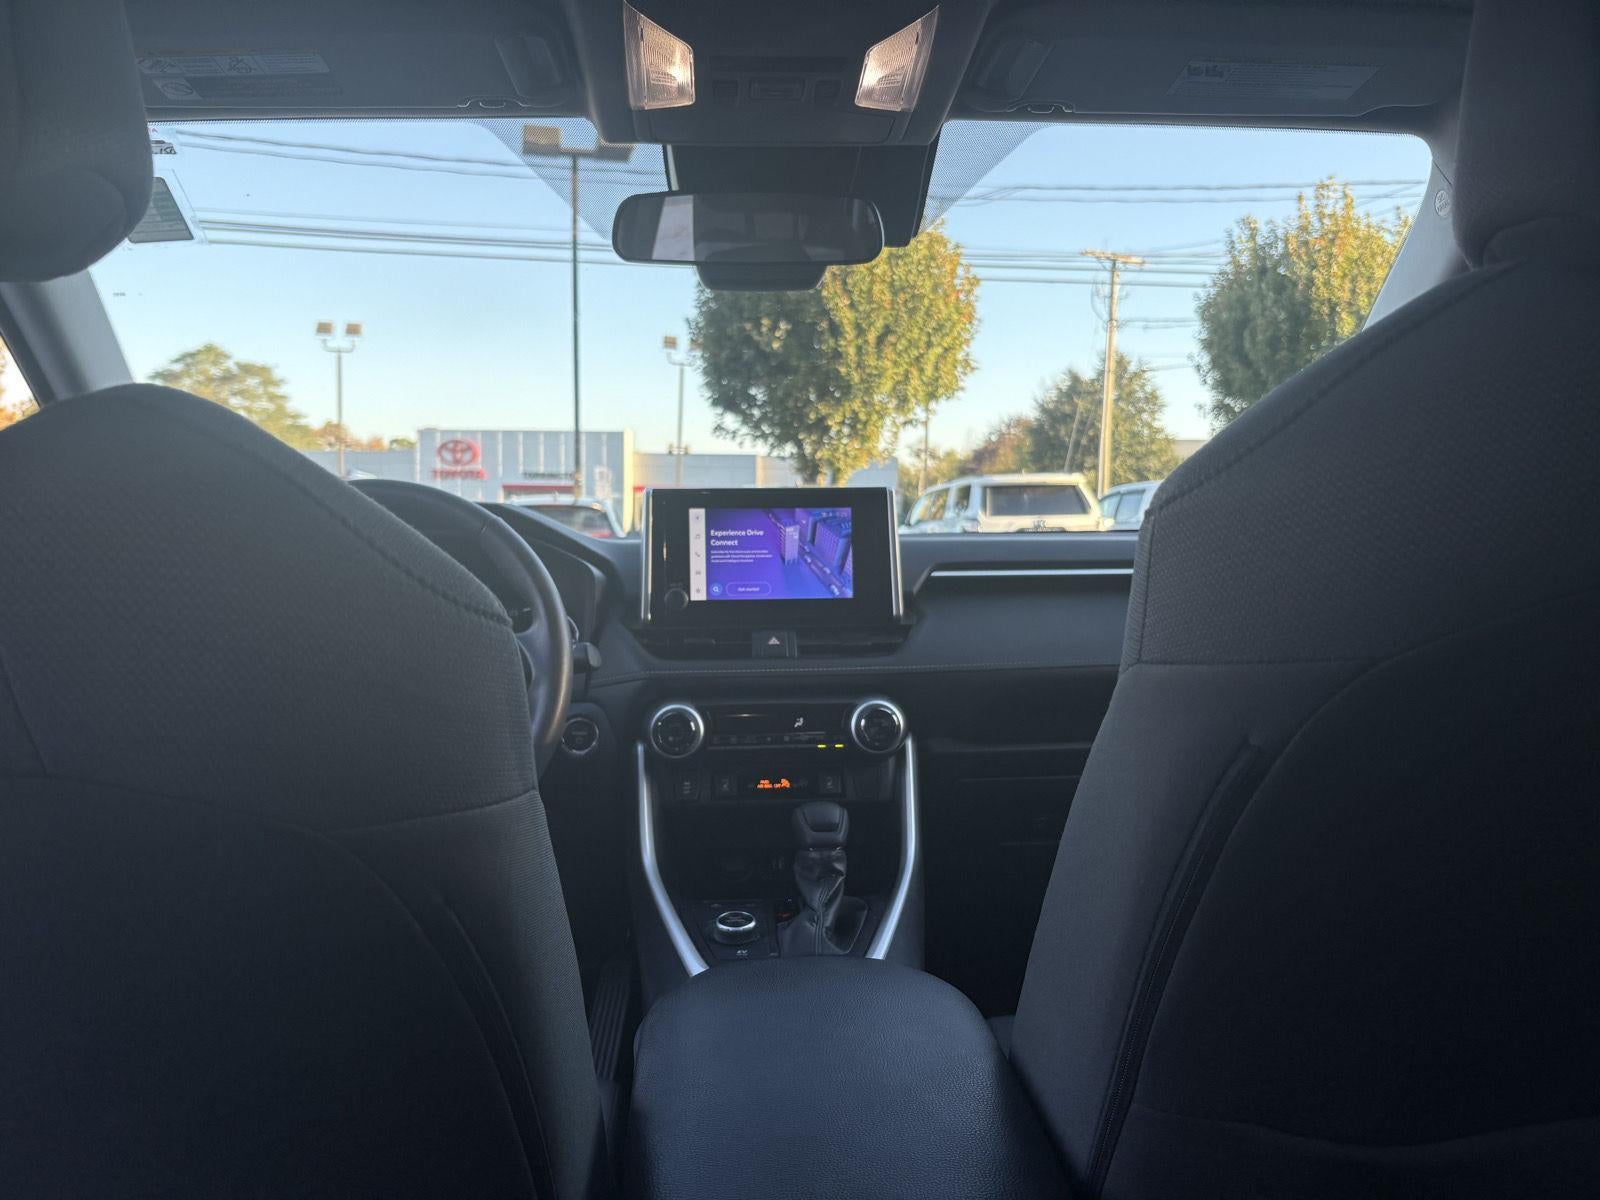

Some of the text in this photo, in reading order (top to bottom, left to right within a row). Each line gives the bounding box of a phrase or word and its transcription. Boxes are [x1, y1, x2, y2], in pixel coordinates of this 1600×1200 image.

[431, 469, 487, 480] TOYOTA
[710, 529, 764, 538] Experience Drive
